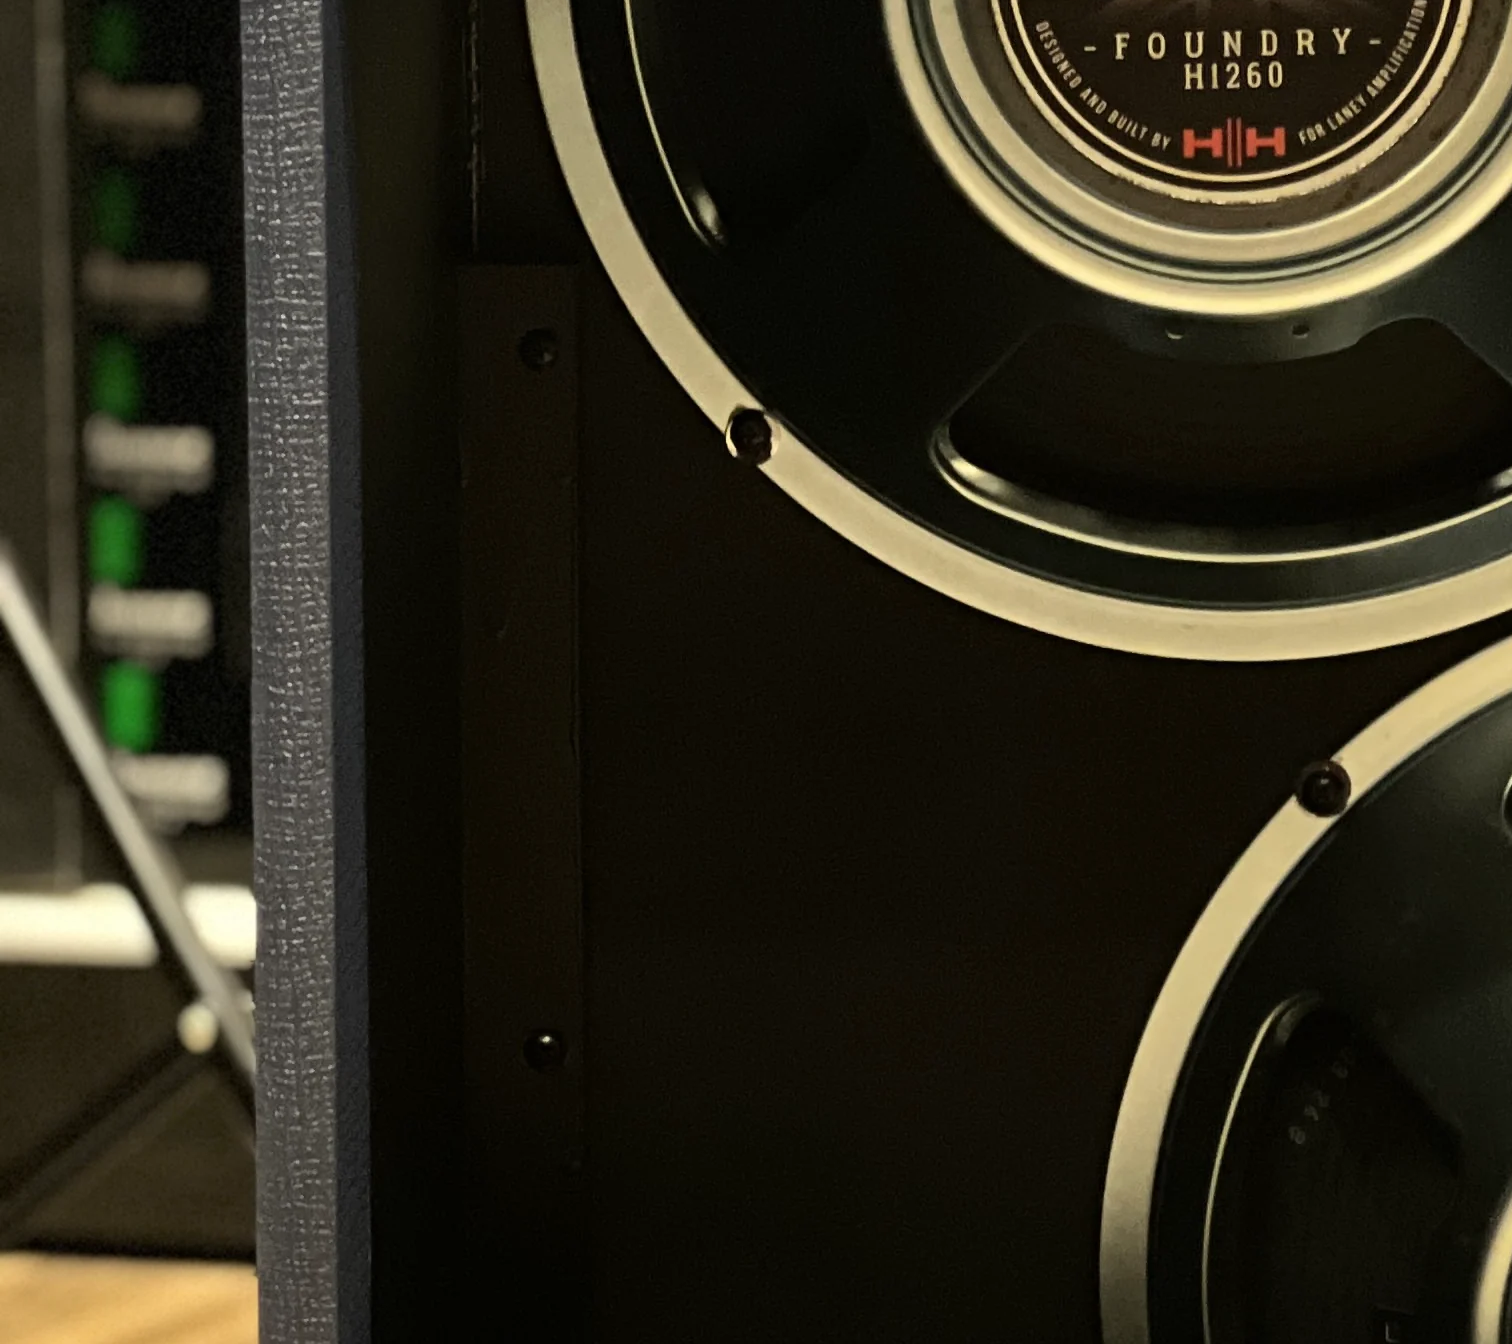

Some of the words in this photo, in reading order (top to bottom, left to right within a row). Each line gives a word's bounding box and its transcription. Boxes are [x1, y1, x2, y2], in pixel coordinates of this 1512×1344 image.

[1115, 28, 1353, 61] FOUNDRY
[1034, 20, 1082, 93] DESIGNED
[1078, 85, 1108, 115] AND
[1108, 106, 1149, 142] BUILT
[1150, 133, 1171, 152] BY
[1299, 124, 1327, 146] FOR
[1327, 92, 1368, 132] LANEY
